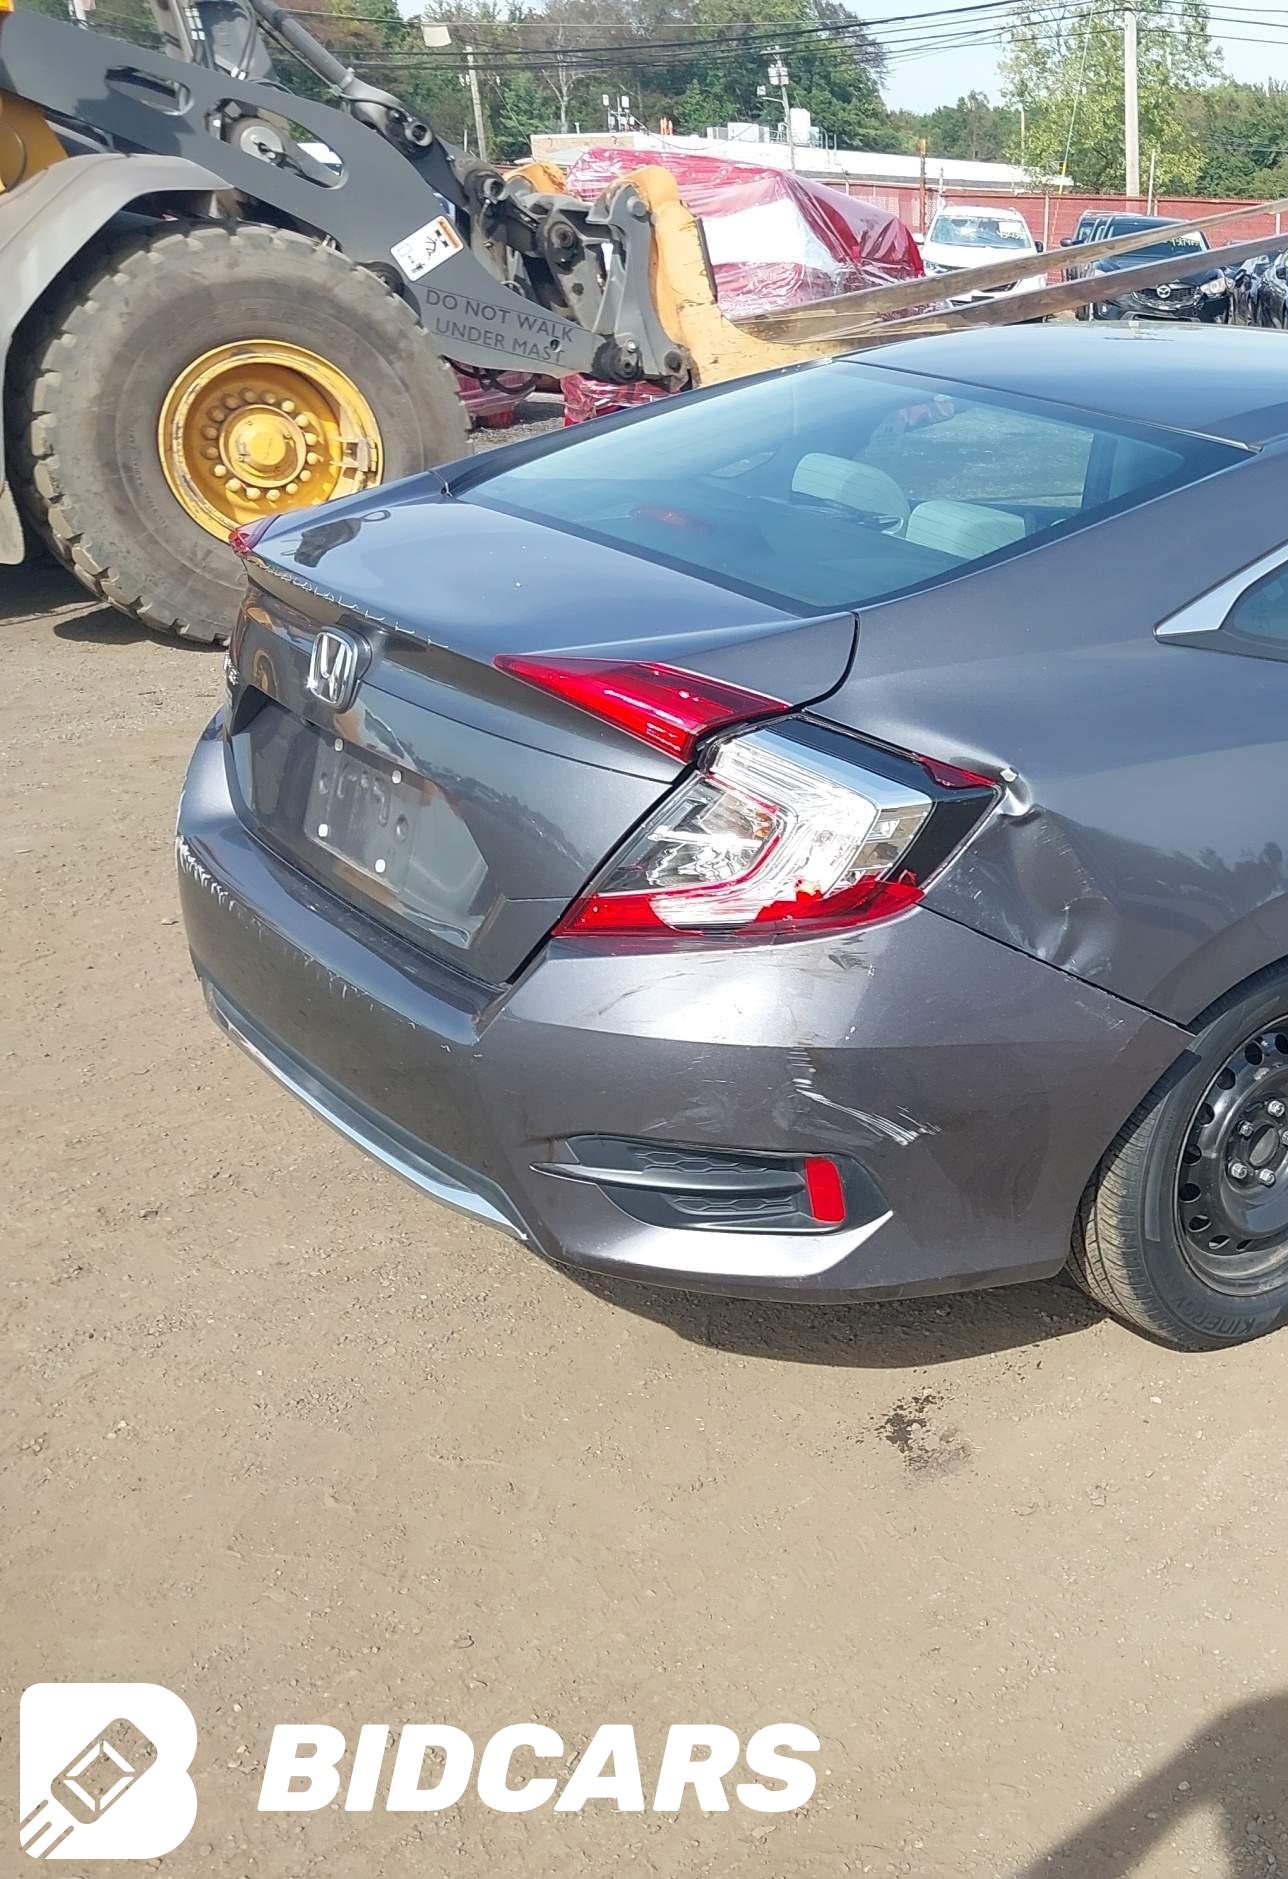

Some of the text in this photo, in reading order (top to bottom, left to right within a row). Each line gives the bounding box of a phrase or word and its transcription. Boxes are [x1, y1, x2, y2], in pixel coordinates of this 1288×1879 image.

[426, 289, 574, 343] DO NOT WALK
[435, 318, 565, 363] UNDER MAST
